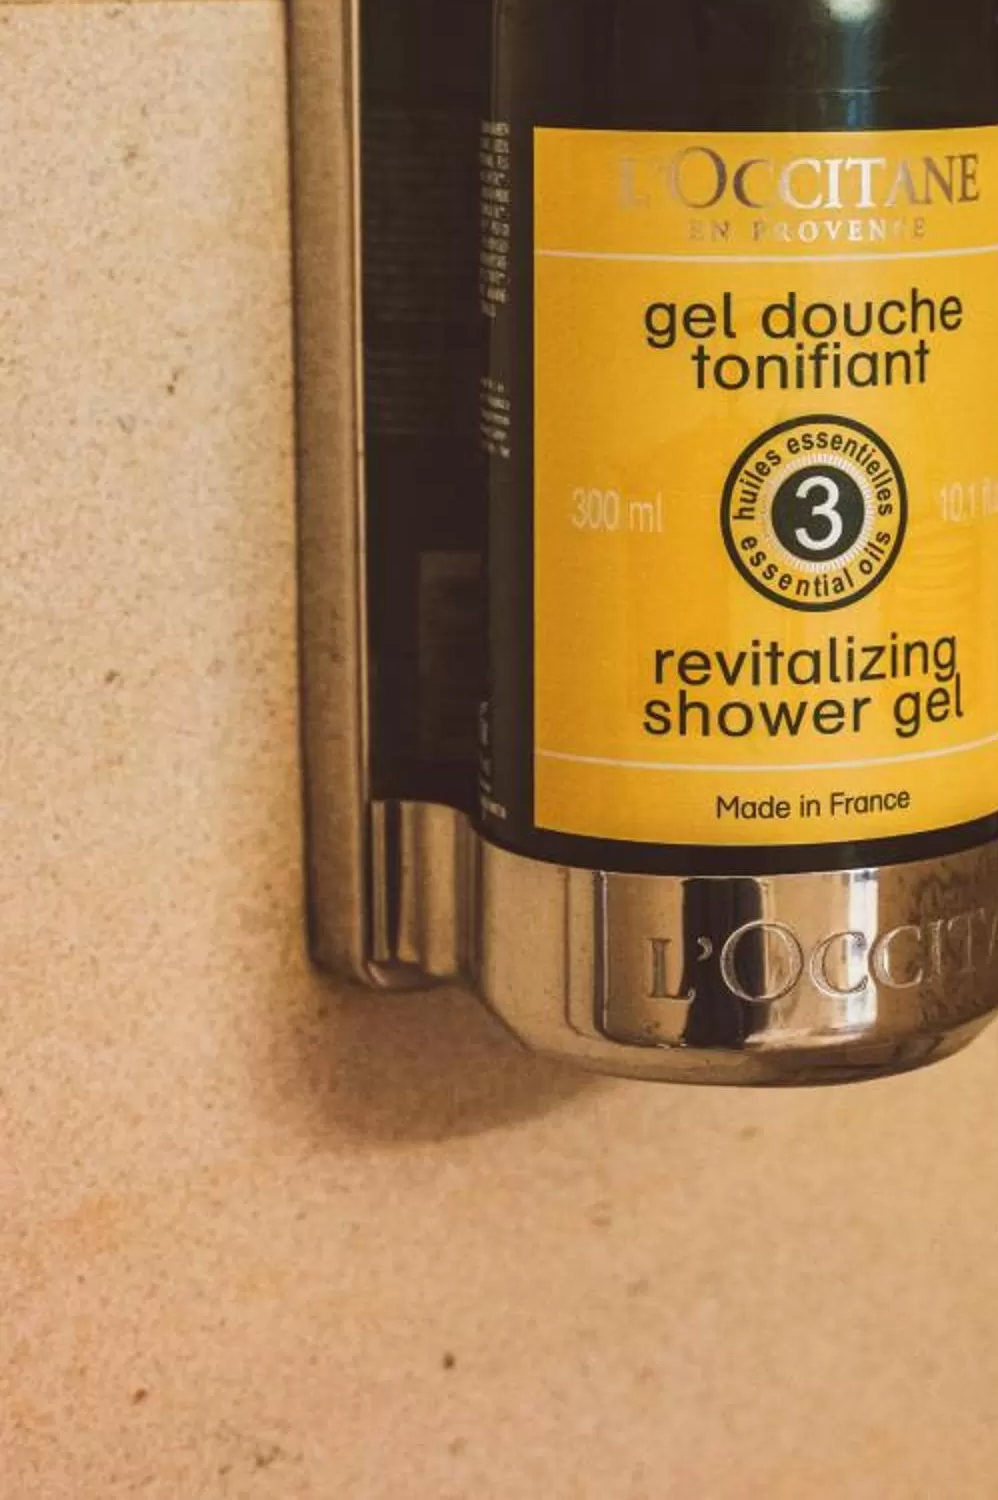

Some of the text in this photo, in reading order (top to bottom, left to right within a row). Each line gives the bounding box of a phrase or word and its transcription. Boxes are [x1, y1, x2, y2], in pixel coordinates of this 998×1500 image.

[686, 218, 732, 243] EN
[643, 287, 963, 348] gel douche
[690, 339, 929, 389] tonifiant
[730, 446, 784, 523] huiles
[784, 428, 895, 518] essentielles
[570, 488, 664, 533] 300 ml
[793, 473, 845, 552] 3
[738, 528, 893, 599] essential oils
[654, 633, 957, 683] revitalizing
[641, 676, 964, 738] shower gel
[714, 788, 912, 822] Made in France
